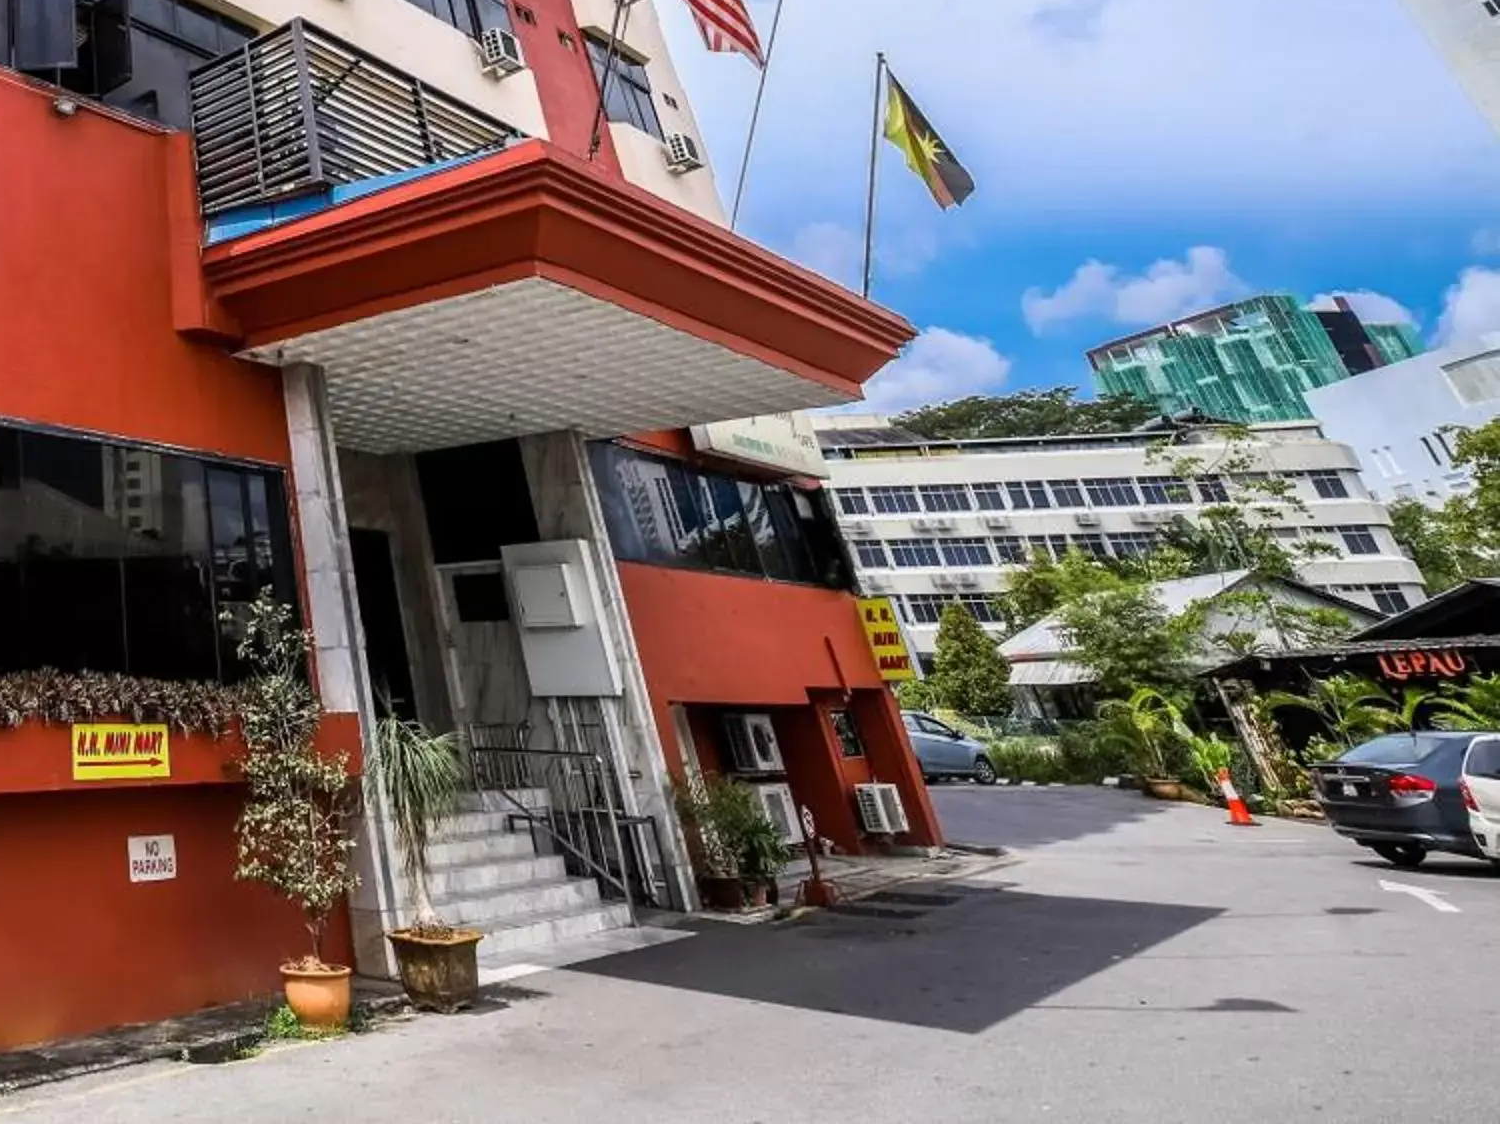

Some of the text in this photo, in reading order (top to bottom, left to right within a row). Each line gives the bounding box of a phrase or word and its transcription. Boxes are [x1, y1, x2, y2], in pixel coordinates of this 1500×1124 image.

[879, 655, 910, 670] MART
[1377, 649, 1466, 681] LEPAU
[103, 731, 132, 756] MINI
[133, 731, 164, 756] MART
[145, 840, 161, 857] NO
[132, 857, 174, 877] PARKING
